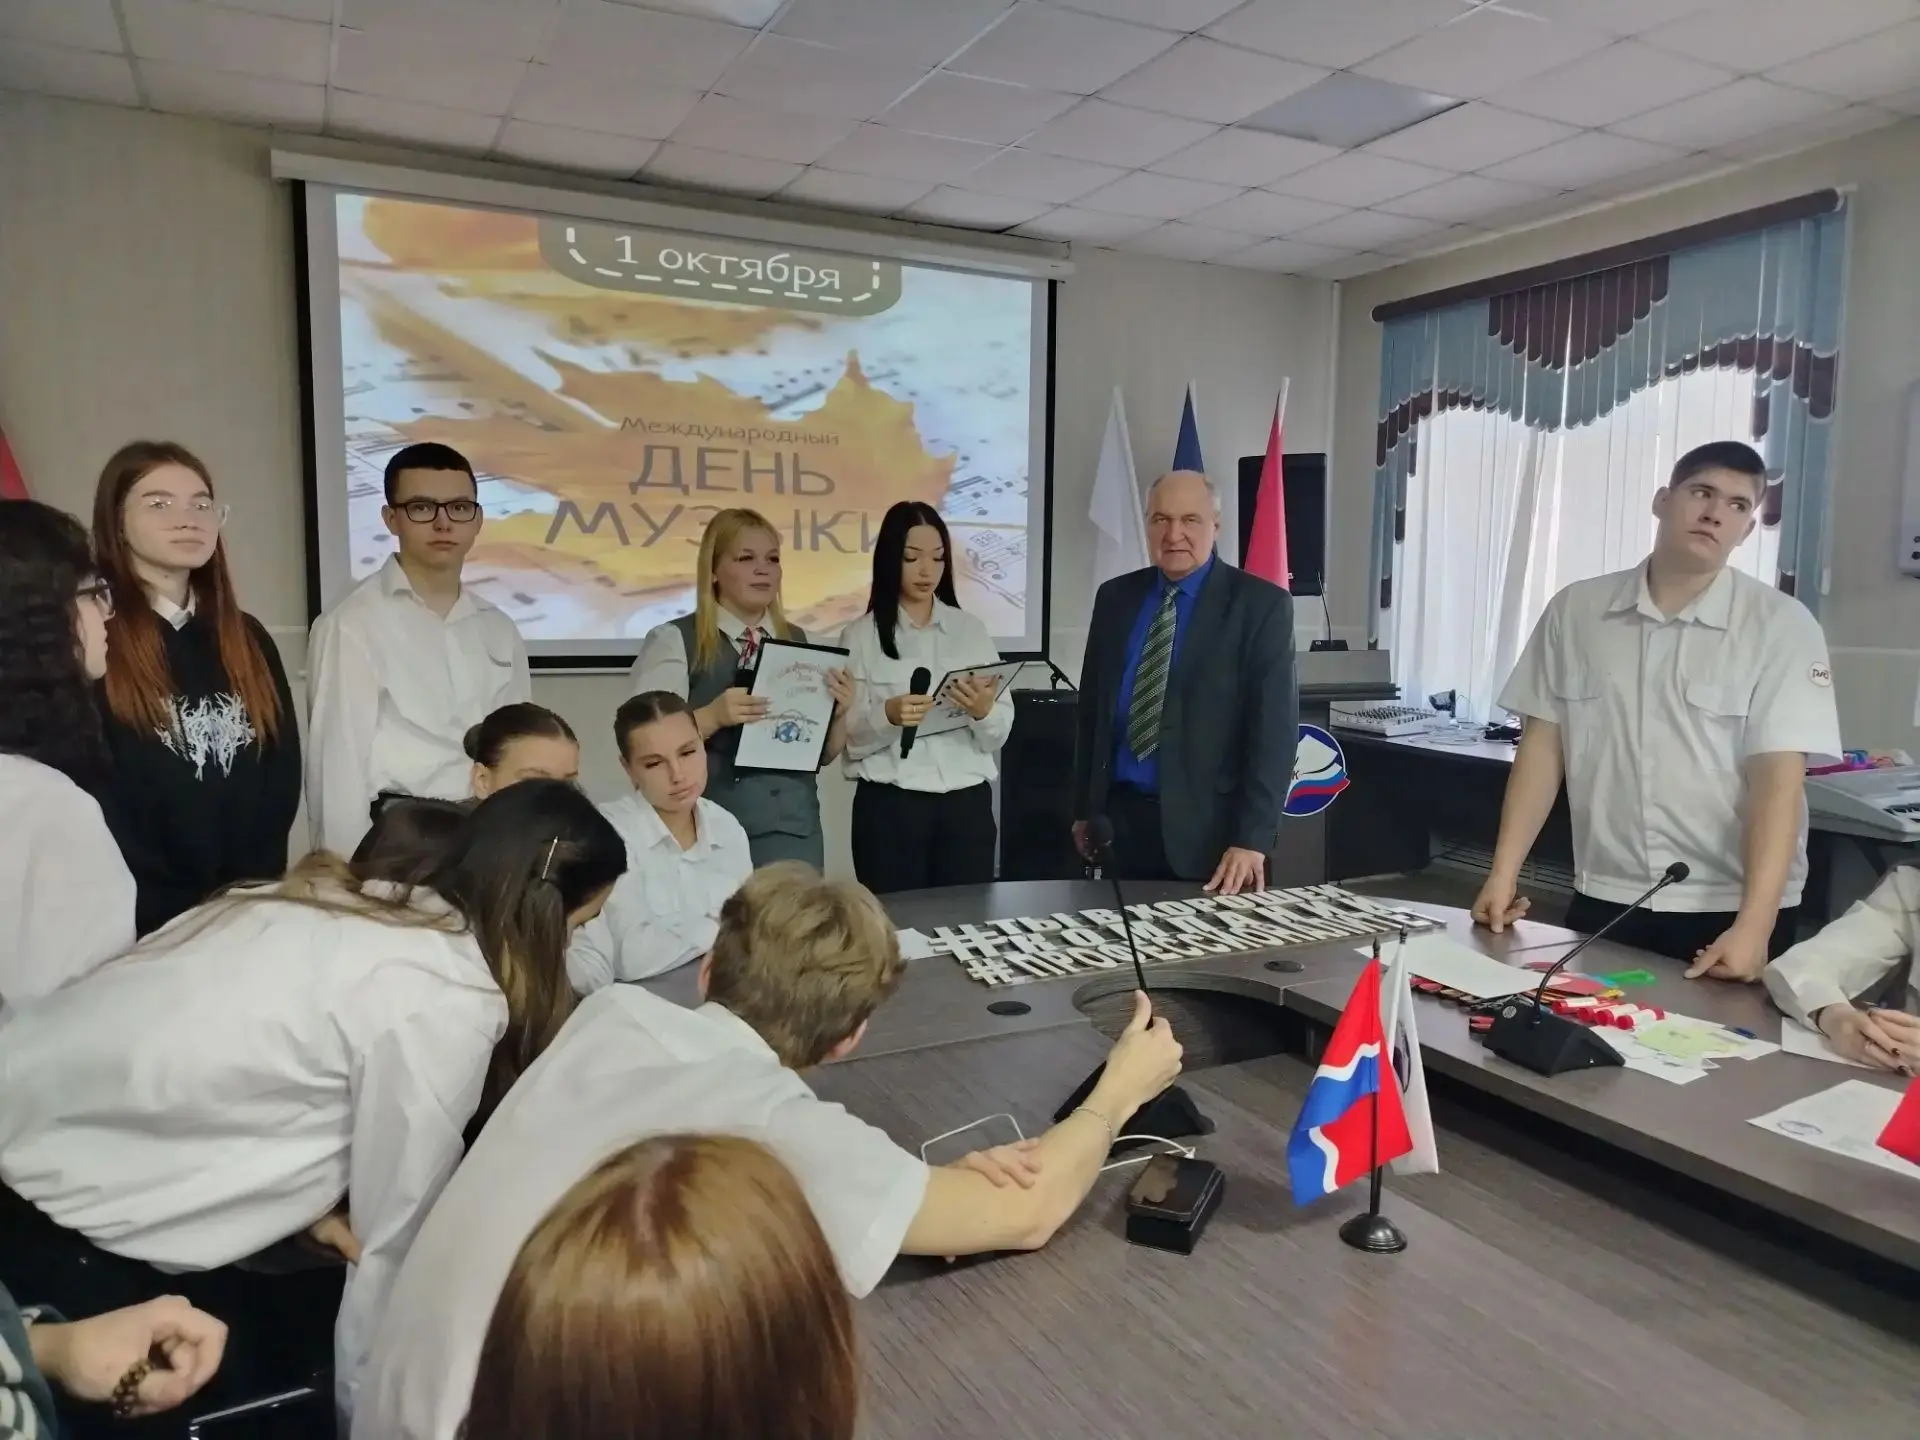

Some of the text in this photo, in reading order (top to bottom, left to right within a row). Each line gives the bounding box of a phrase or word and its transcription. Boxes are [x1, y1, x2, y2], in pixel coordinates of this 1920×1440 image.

[614, 235, 840, 292] 1 октября
[620, 417, 840, 446] Международный
[628, 445, 836, 496] ДЕНЬ
